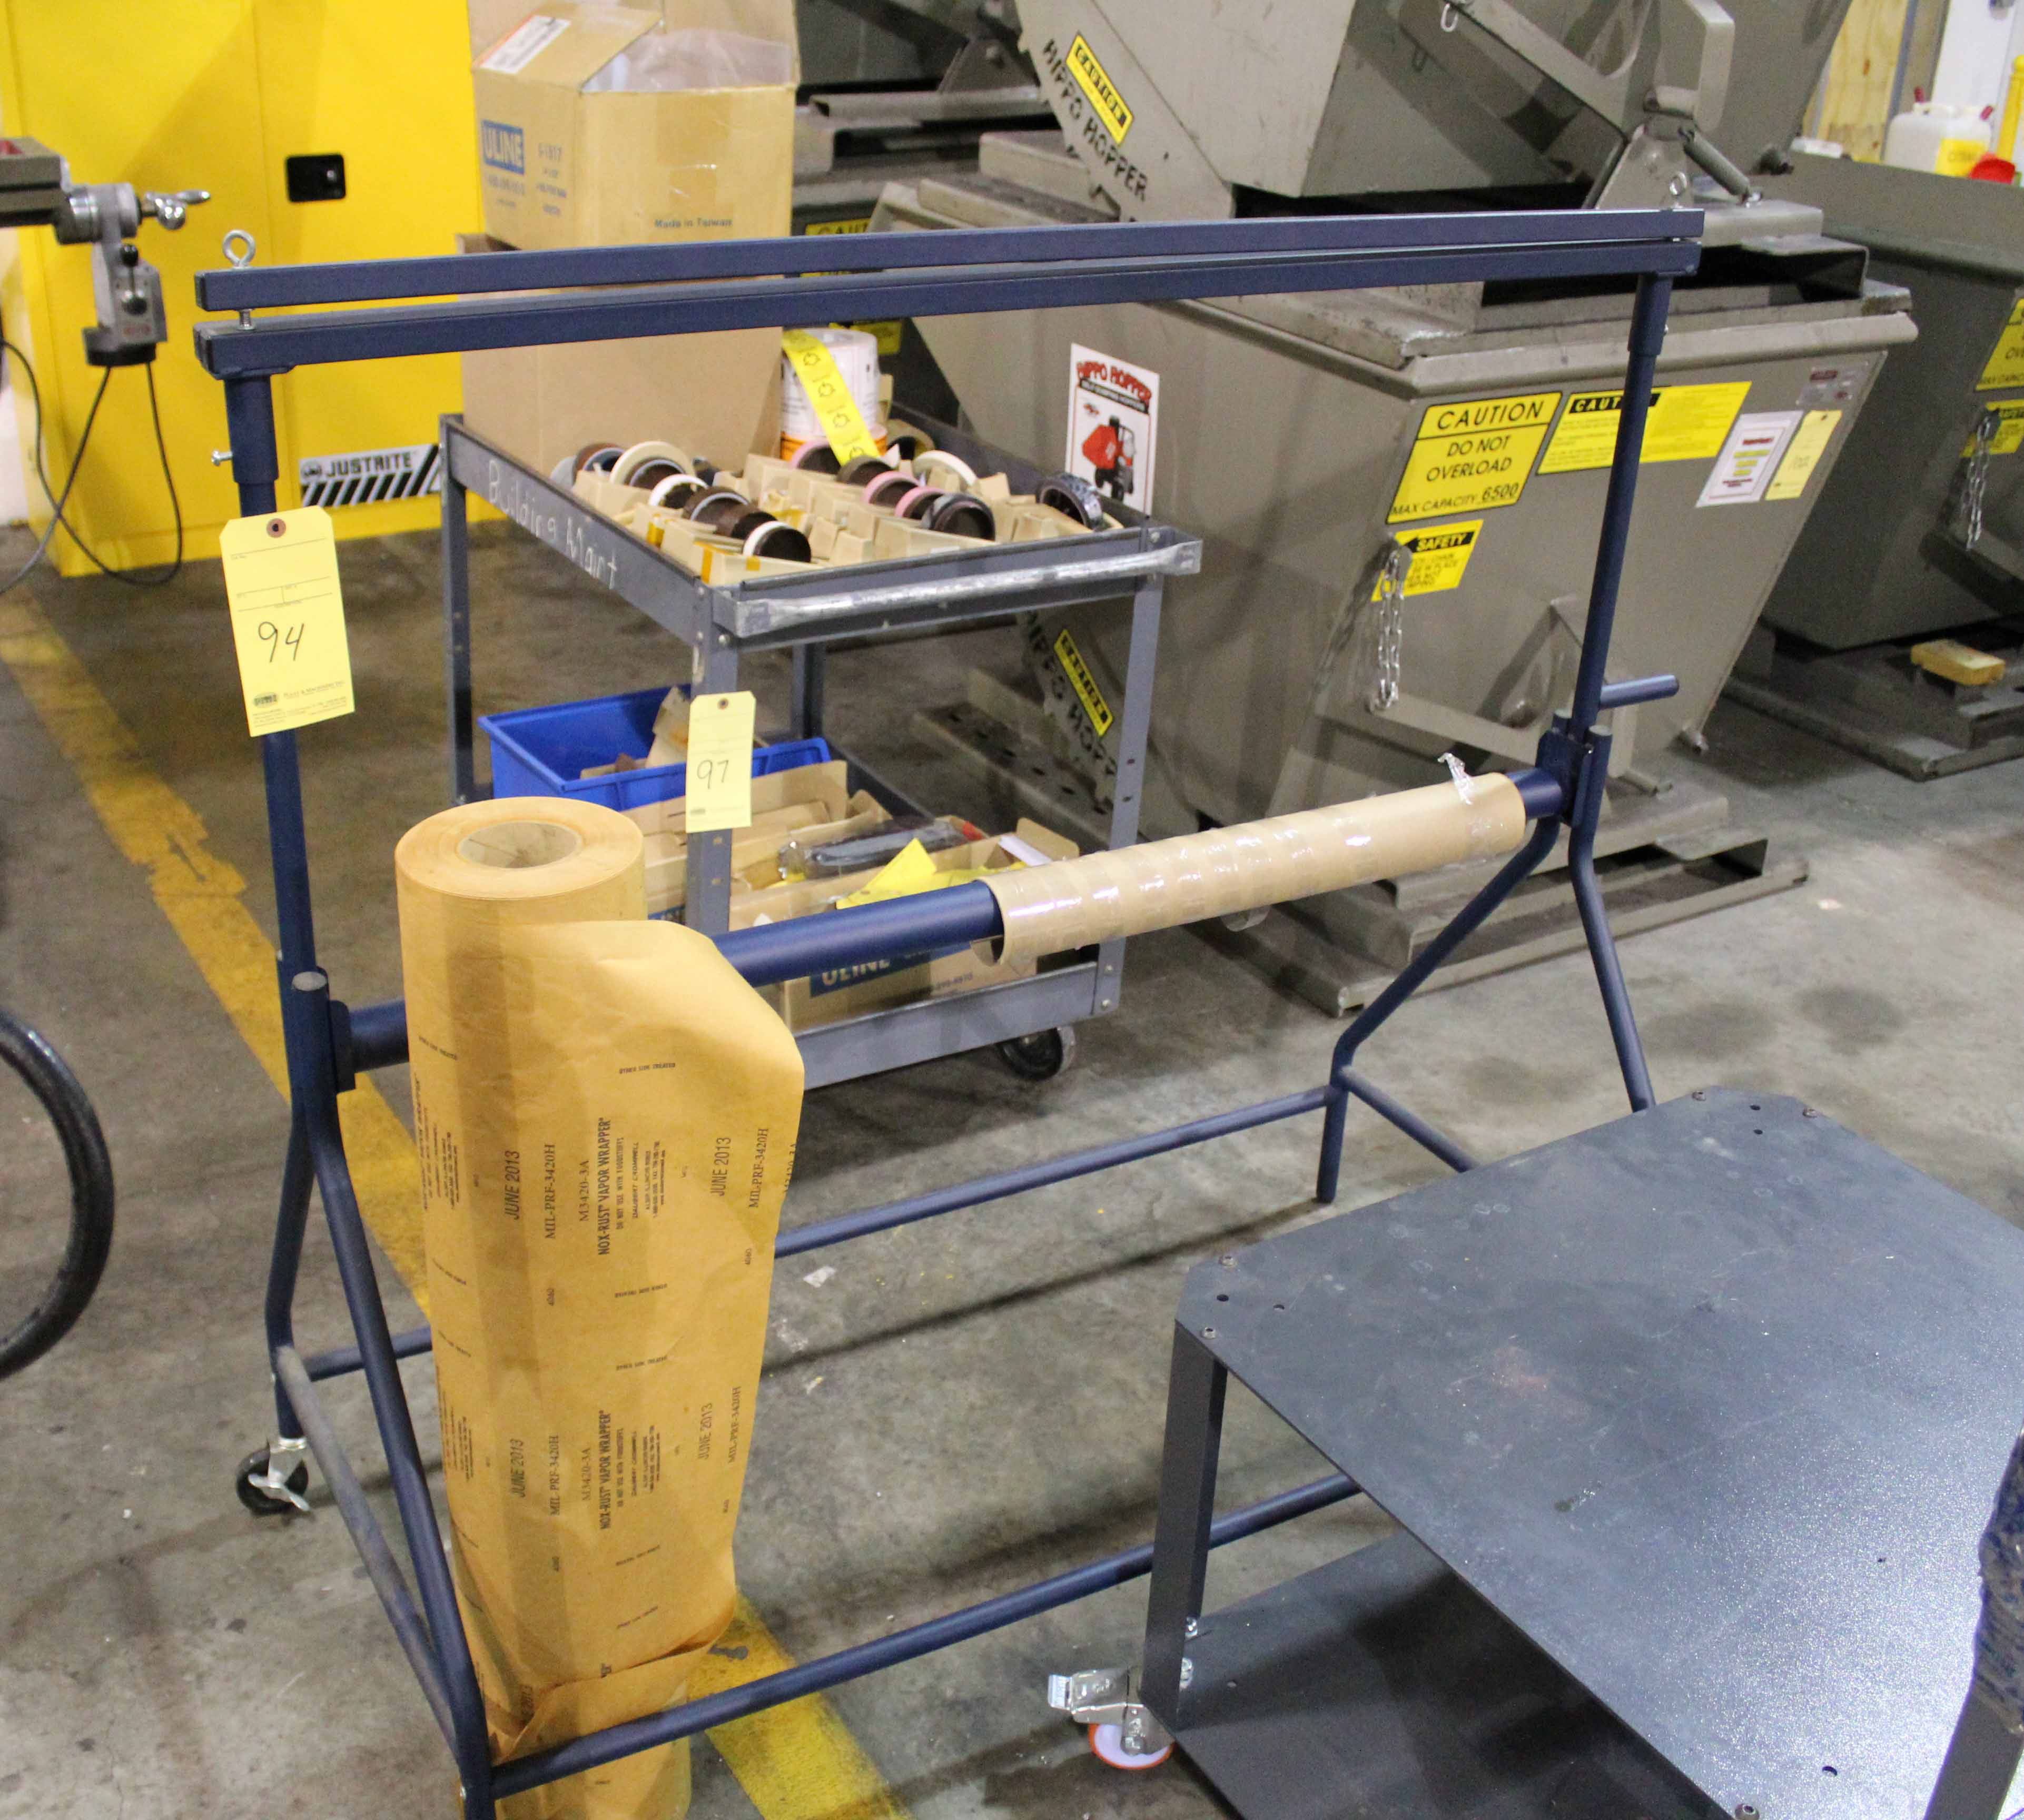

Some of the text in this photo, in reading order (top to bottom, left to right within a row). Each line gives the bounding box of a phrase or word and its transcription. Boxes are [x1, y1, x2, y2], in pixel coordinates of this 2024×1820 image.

[483, 126, 522, 165] ULINE
[1083, 117, 1148, 202] HOPPER
[655, 218, 682, 228] Made
[696, 217, 733, 227] Taiwan
[1438, 401, 1544, 430] CAUTION
[1575, 396, 1622, 412] CAUT
[326, 451, 412, 476] JUSTRITE
[1447, 436, 1511, 457] DO NOT
[1427, 457, 1512, 481] OVERLOAD
[1393, 482, 1519, 515] MAX CAPACITY 6500
[1416, 533, 1467, 552] SAFETY
[258, 621, 304, 662] 94
[697, 759, 729, 789] 97
[710, 1138, 731, 1196] JUNE 2013
[748, 1129, 768, 1208] MIL-PRF-3420H
[505, 1151, 520, 1220] JUNE 2013
[545, 1144, 556, 1239] MIL-PRF-3420H
[578, 1161, 589, 1221] M3420-3A
[598, 1170, 610, 1202] VAPOR
[698, 1403, 713, 1460] JUNE 2013
[728, 1387, 741, 1464] MIL-PRF-3420H
[509, 1439, 525, 1498] JUNE 2013
[599, 1456, 611, 1483] VAPOR
